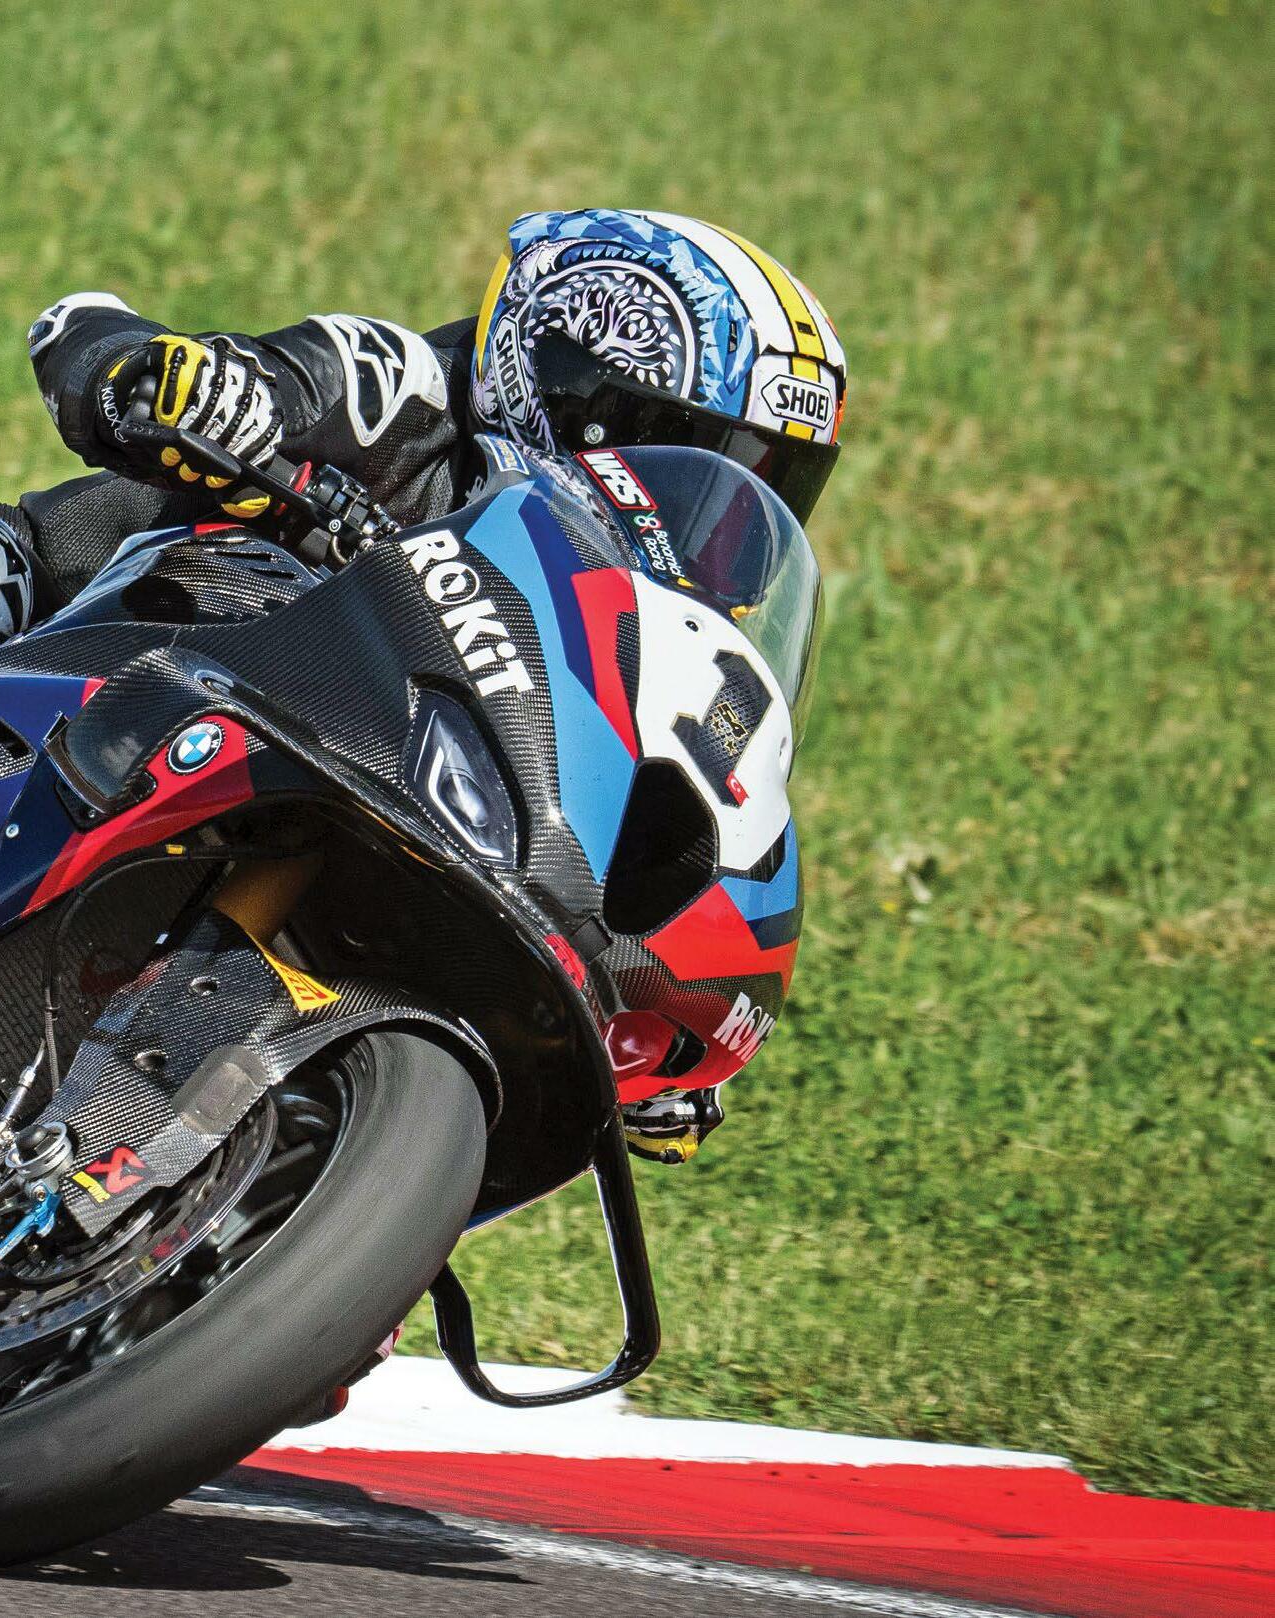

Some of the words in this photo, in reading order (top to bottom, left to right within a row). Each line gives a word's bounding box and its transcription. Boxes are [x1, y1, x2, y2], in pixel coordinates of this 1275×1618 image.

[496, 329, 524, 411] SHOEI
[101, 386, 122, 427] KNOX
[775, 383, 829, 422] SHOEI
[583, 452, 651, 507] WRS
[643, 537, 666, 571] Racing
[400, 529, 535, 698] ROKiT
[670, 648, 774, 809] 1
